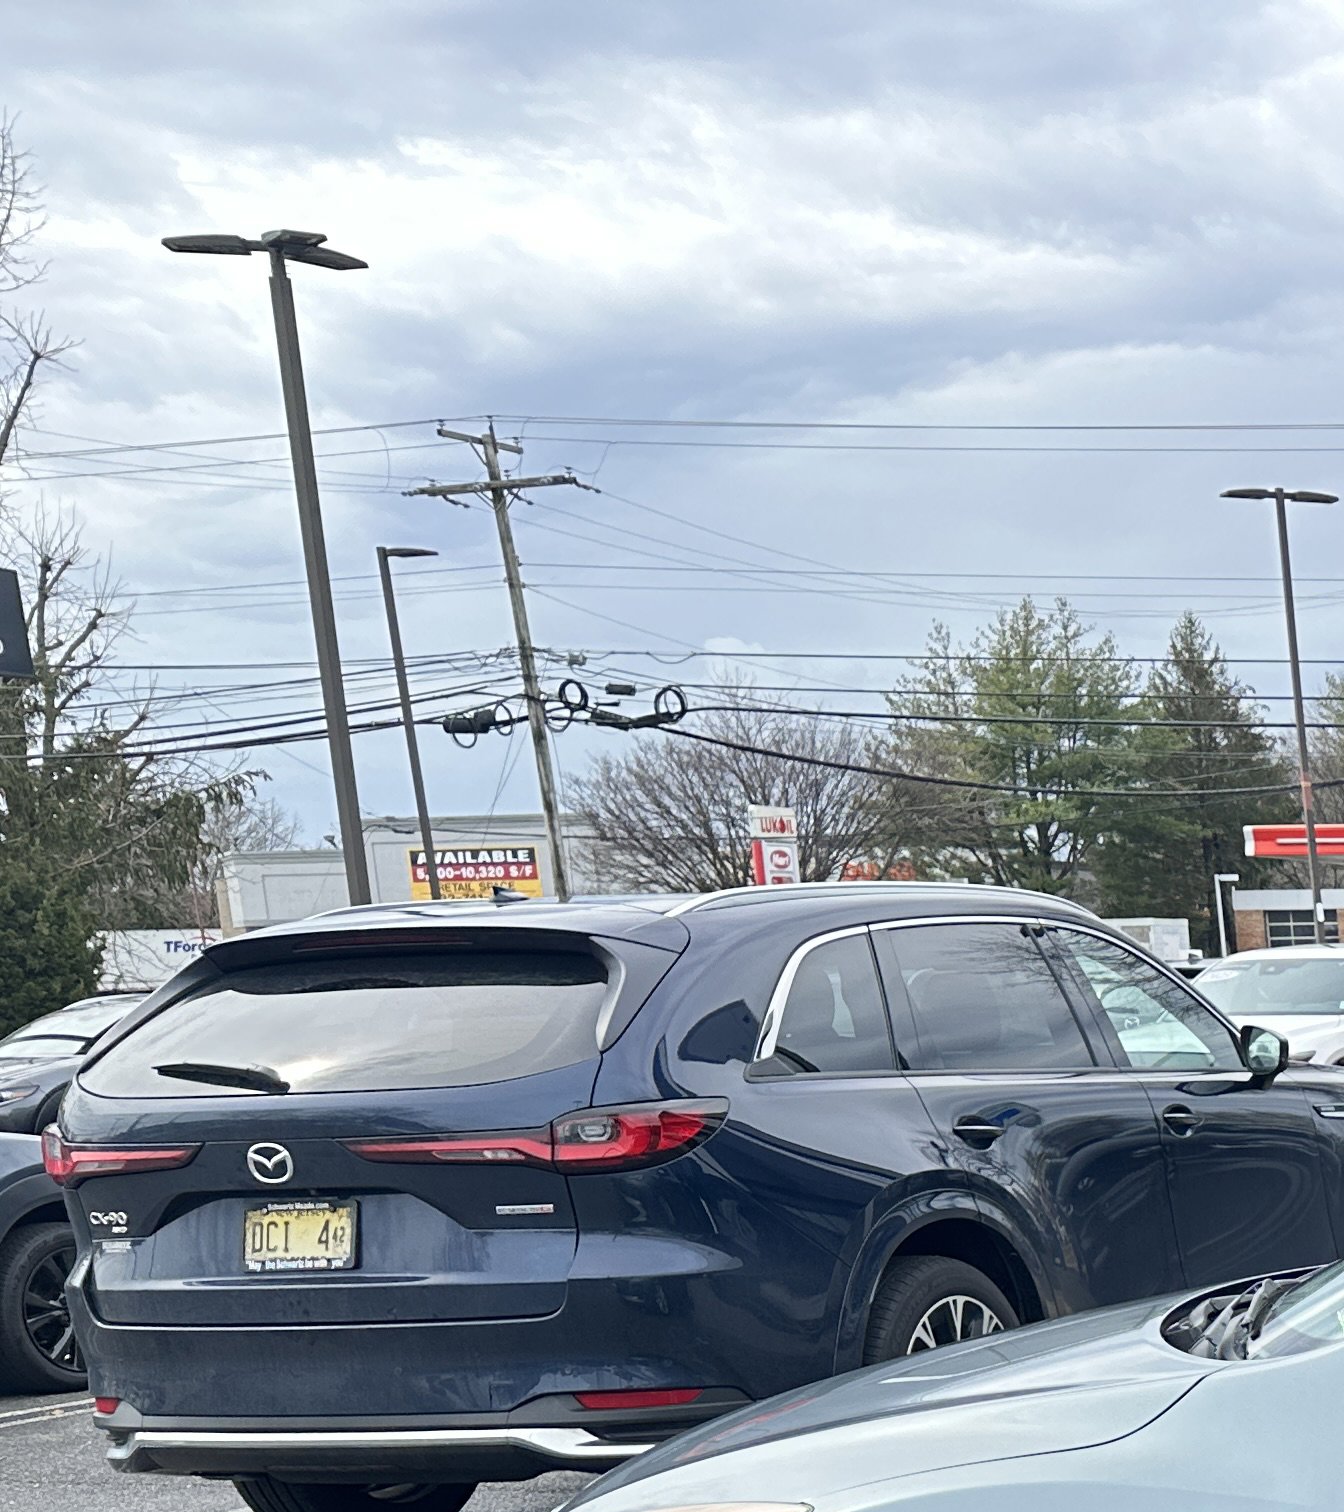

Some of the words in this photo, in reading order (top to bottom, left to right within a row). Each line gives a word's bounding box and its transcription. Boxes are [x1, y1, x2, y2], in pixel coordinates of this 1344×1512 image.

[773, 853, 789, 866] Mart
[416, 865, 504, 880] 5,00-10,320
[509, 865, 533, 877] S/F
[164, 940, 210, 954] TForc
[251, 1220, 290, 1254] DCI
